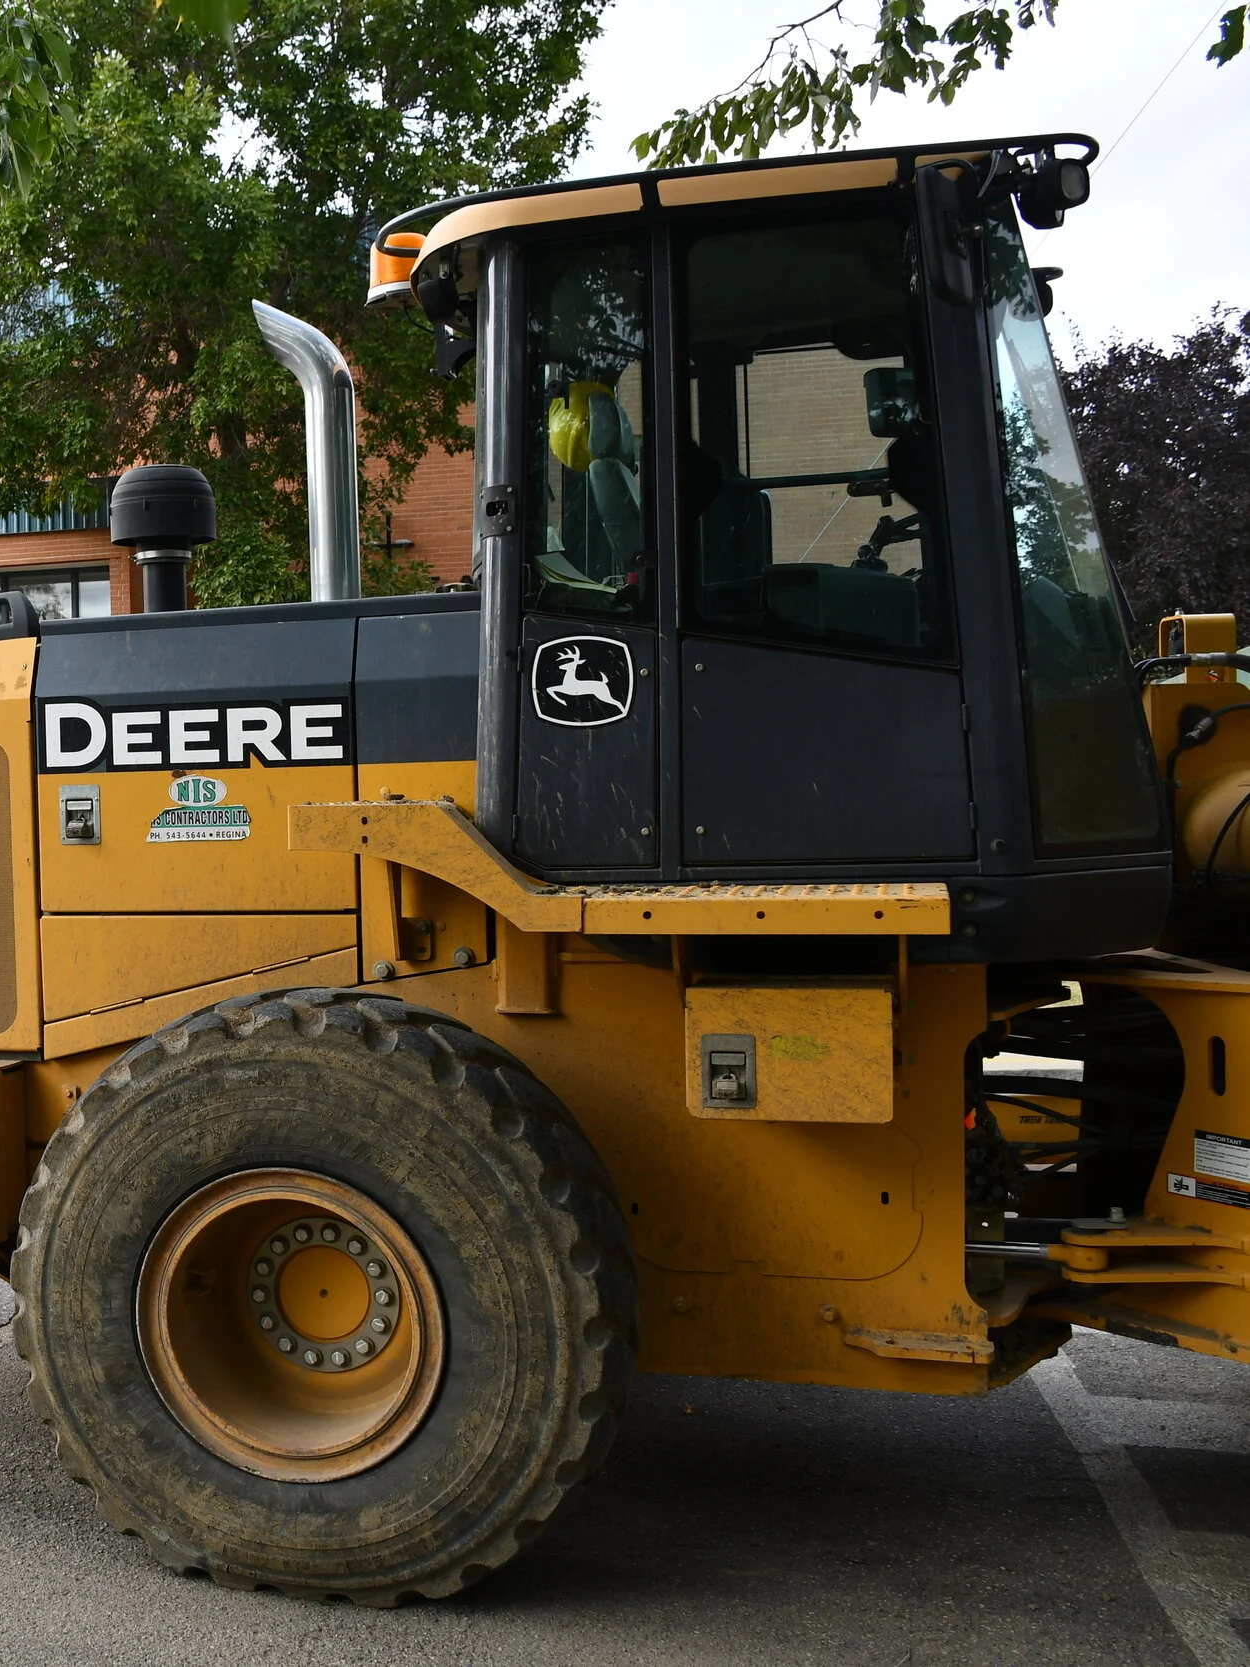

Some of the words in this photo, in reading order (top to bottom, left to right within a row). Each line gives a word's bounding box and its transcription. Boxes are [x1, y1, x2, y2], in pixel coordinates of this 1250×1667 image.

[44, 702, 344, 767] DEERE
[176, 778, 217, 803] NIS
[165, 810, 229, 825] CONTRACTORS
[216, 830, 247, 839] REGINA
[1205, 1134, 1243, 1146] IMPORTANT
